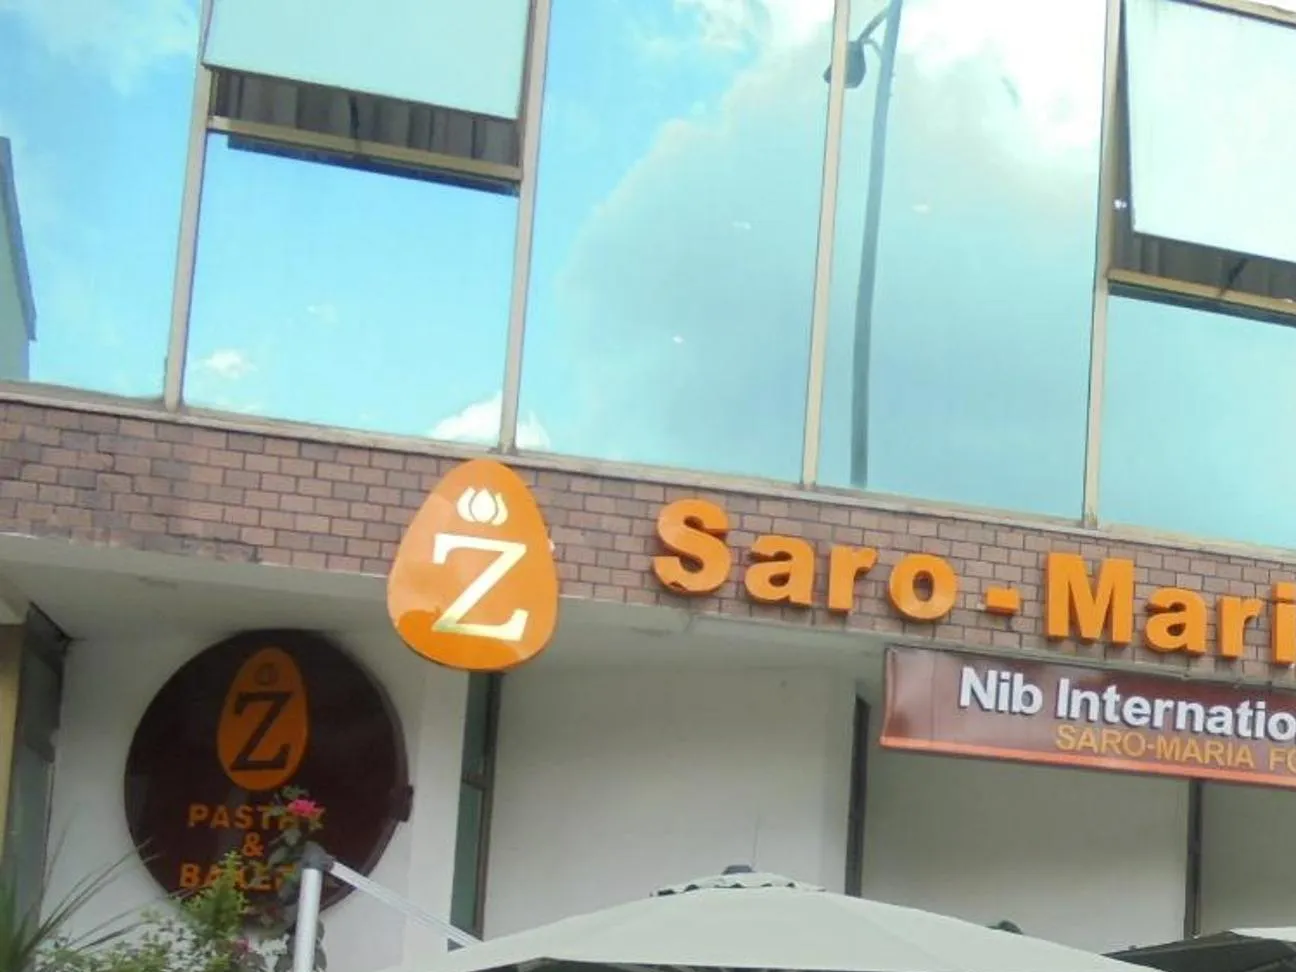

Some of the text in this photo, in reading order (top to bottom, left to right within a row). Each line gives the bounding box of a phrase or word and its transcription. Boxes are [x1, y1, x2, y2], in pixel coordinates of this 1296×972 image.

[431, 532, 530, 642] Z
[959, 666, 1043, 715] Nib
[229, 691, 293, 772] Z
[1056, 724, 1255, 770] SARO-MARIA
[243, 832, 264, 857] &
